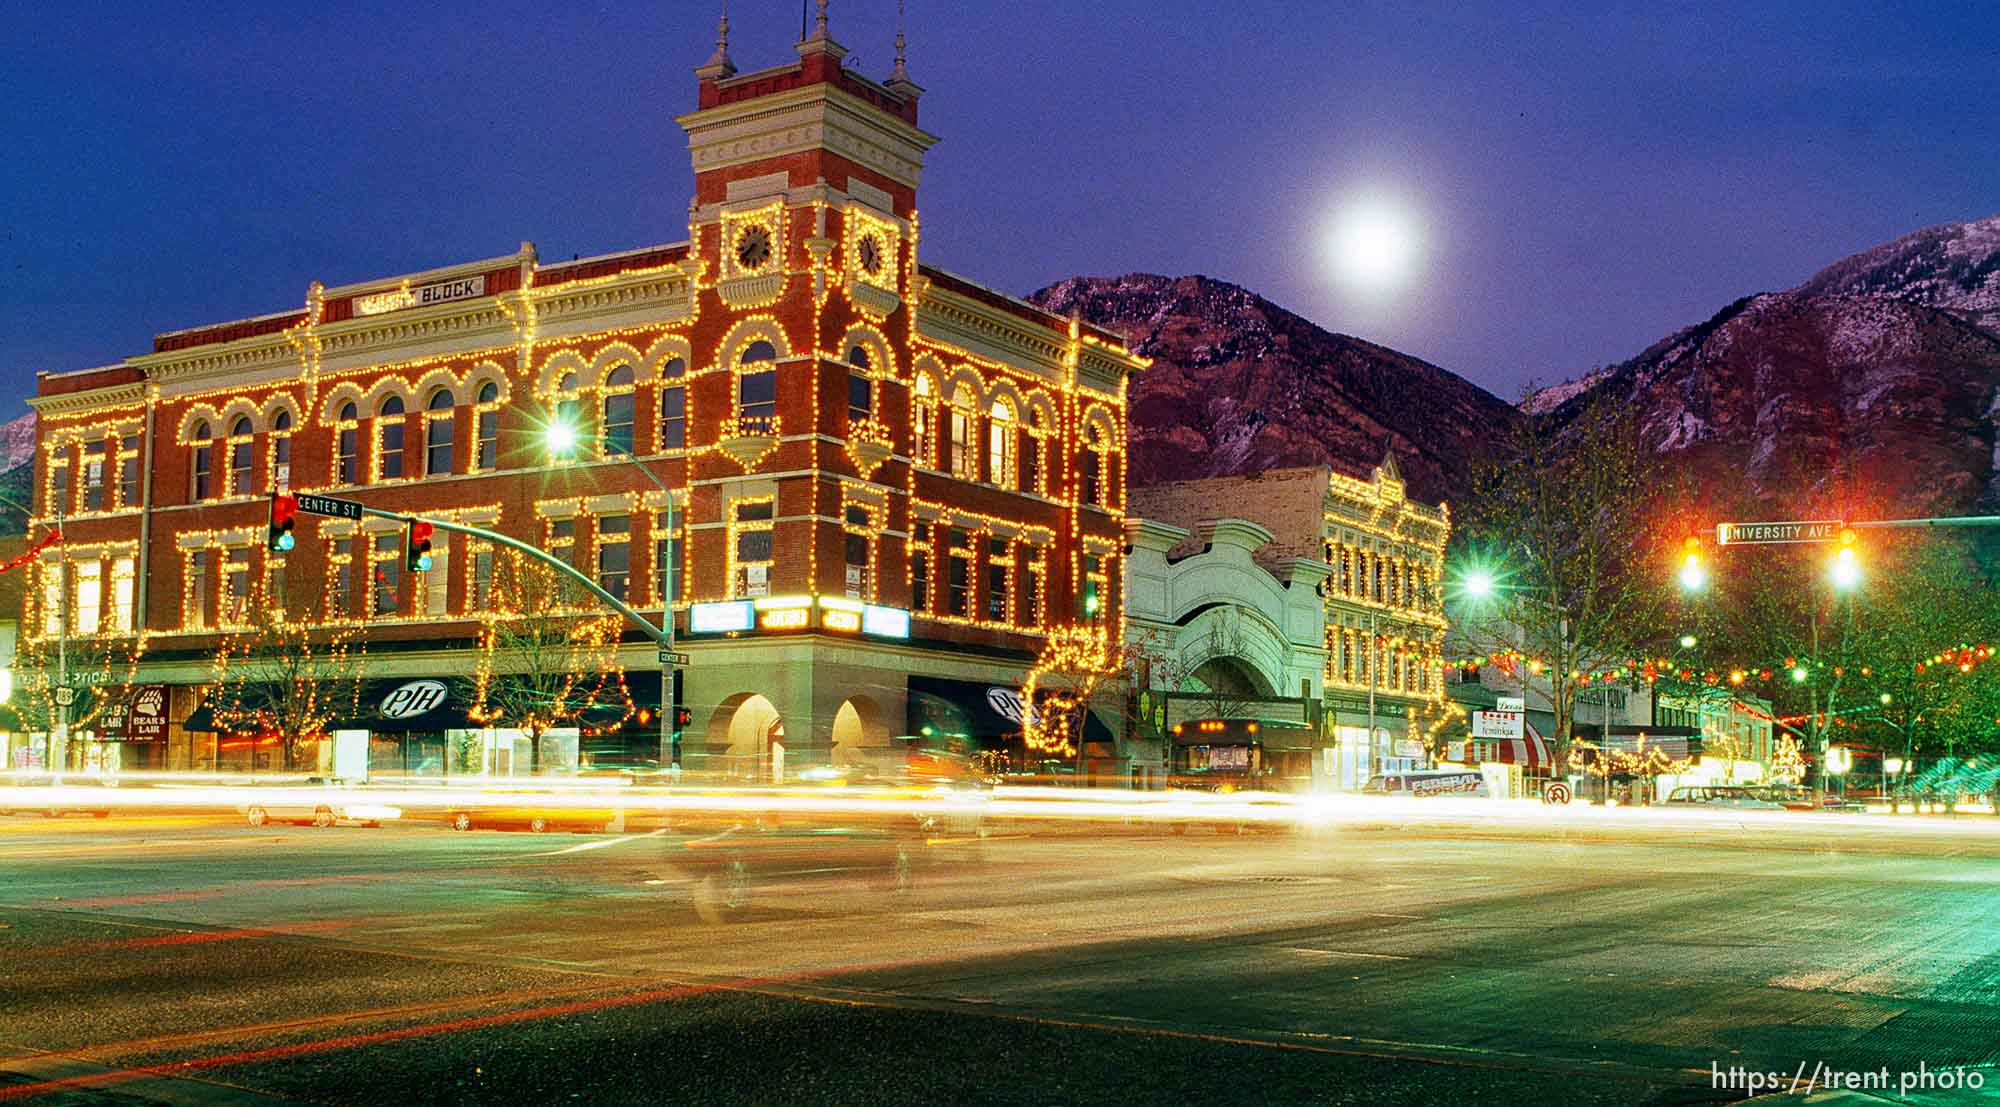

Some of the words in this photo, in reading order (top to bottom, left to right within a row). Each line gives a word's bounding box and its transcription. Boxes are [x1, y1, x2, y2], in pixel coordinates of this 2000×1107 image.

[422, 279, 475, 303] BLOCK
[297, 496, 338, 513] CENTER
[384, 686, 445, 717] PJH
[100, 716, 122, 728] LAIR
[139, 725, 160, 734] LAIR
